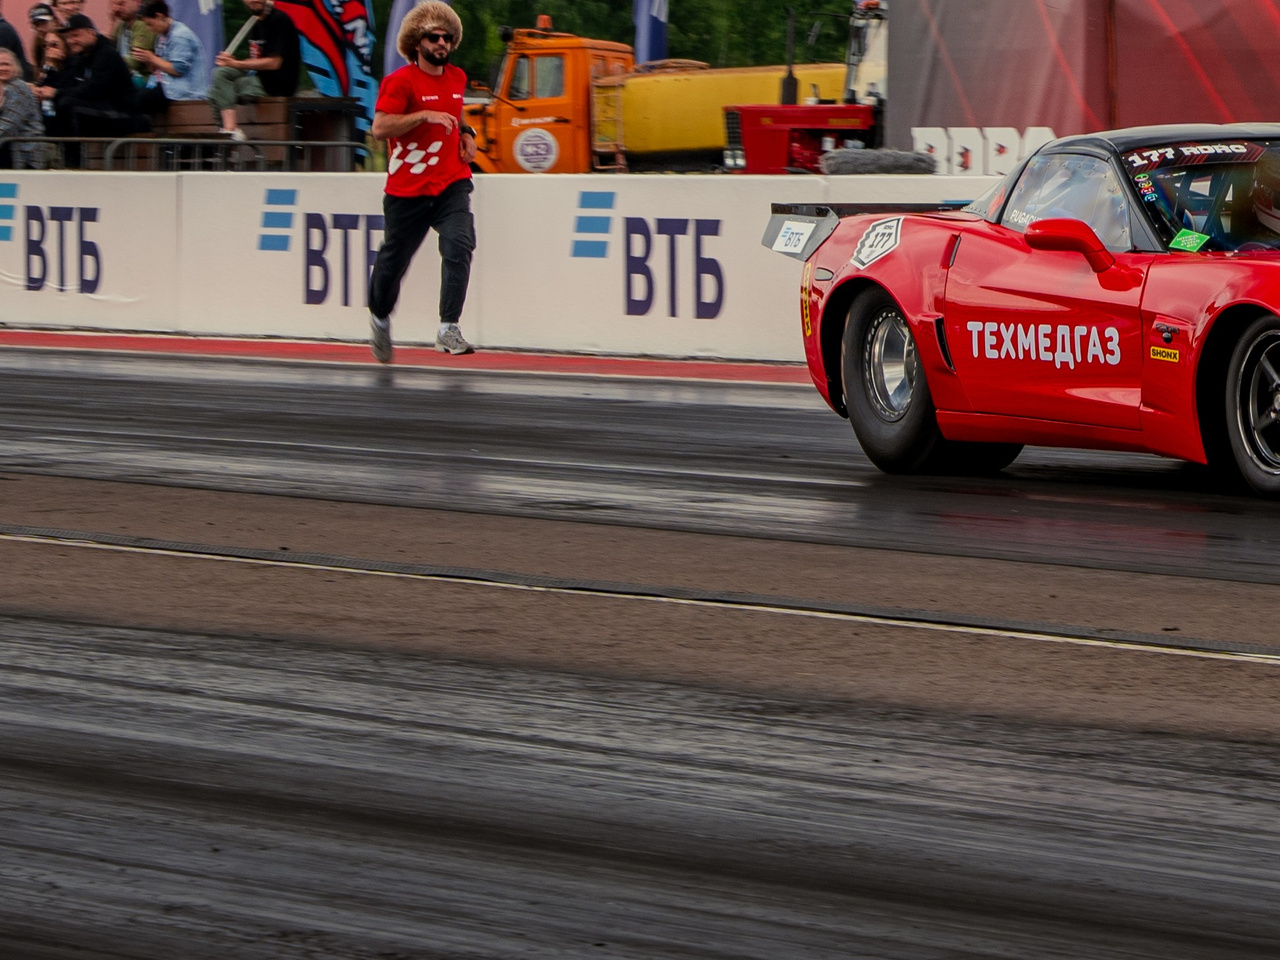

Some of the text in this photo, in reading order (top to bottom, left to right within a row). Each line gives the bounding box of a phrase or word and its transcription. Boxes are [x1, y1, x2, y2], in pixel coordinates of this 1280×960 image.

[1128, 147, 1175, 167] 177
[25, 205, 102, 294] ВТБ
[784, 231, 804, 248] ВТБ
[868, 232, 893, 248] 177
[624, 217, 724, 319] ВТБ
[967, 321, 1121, 370] ТЕХМЕДГАЗ
[1151, 348, 1178, 360] SHONX
